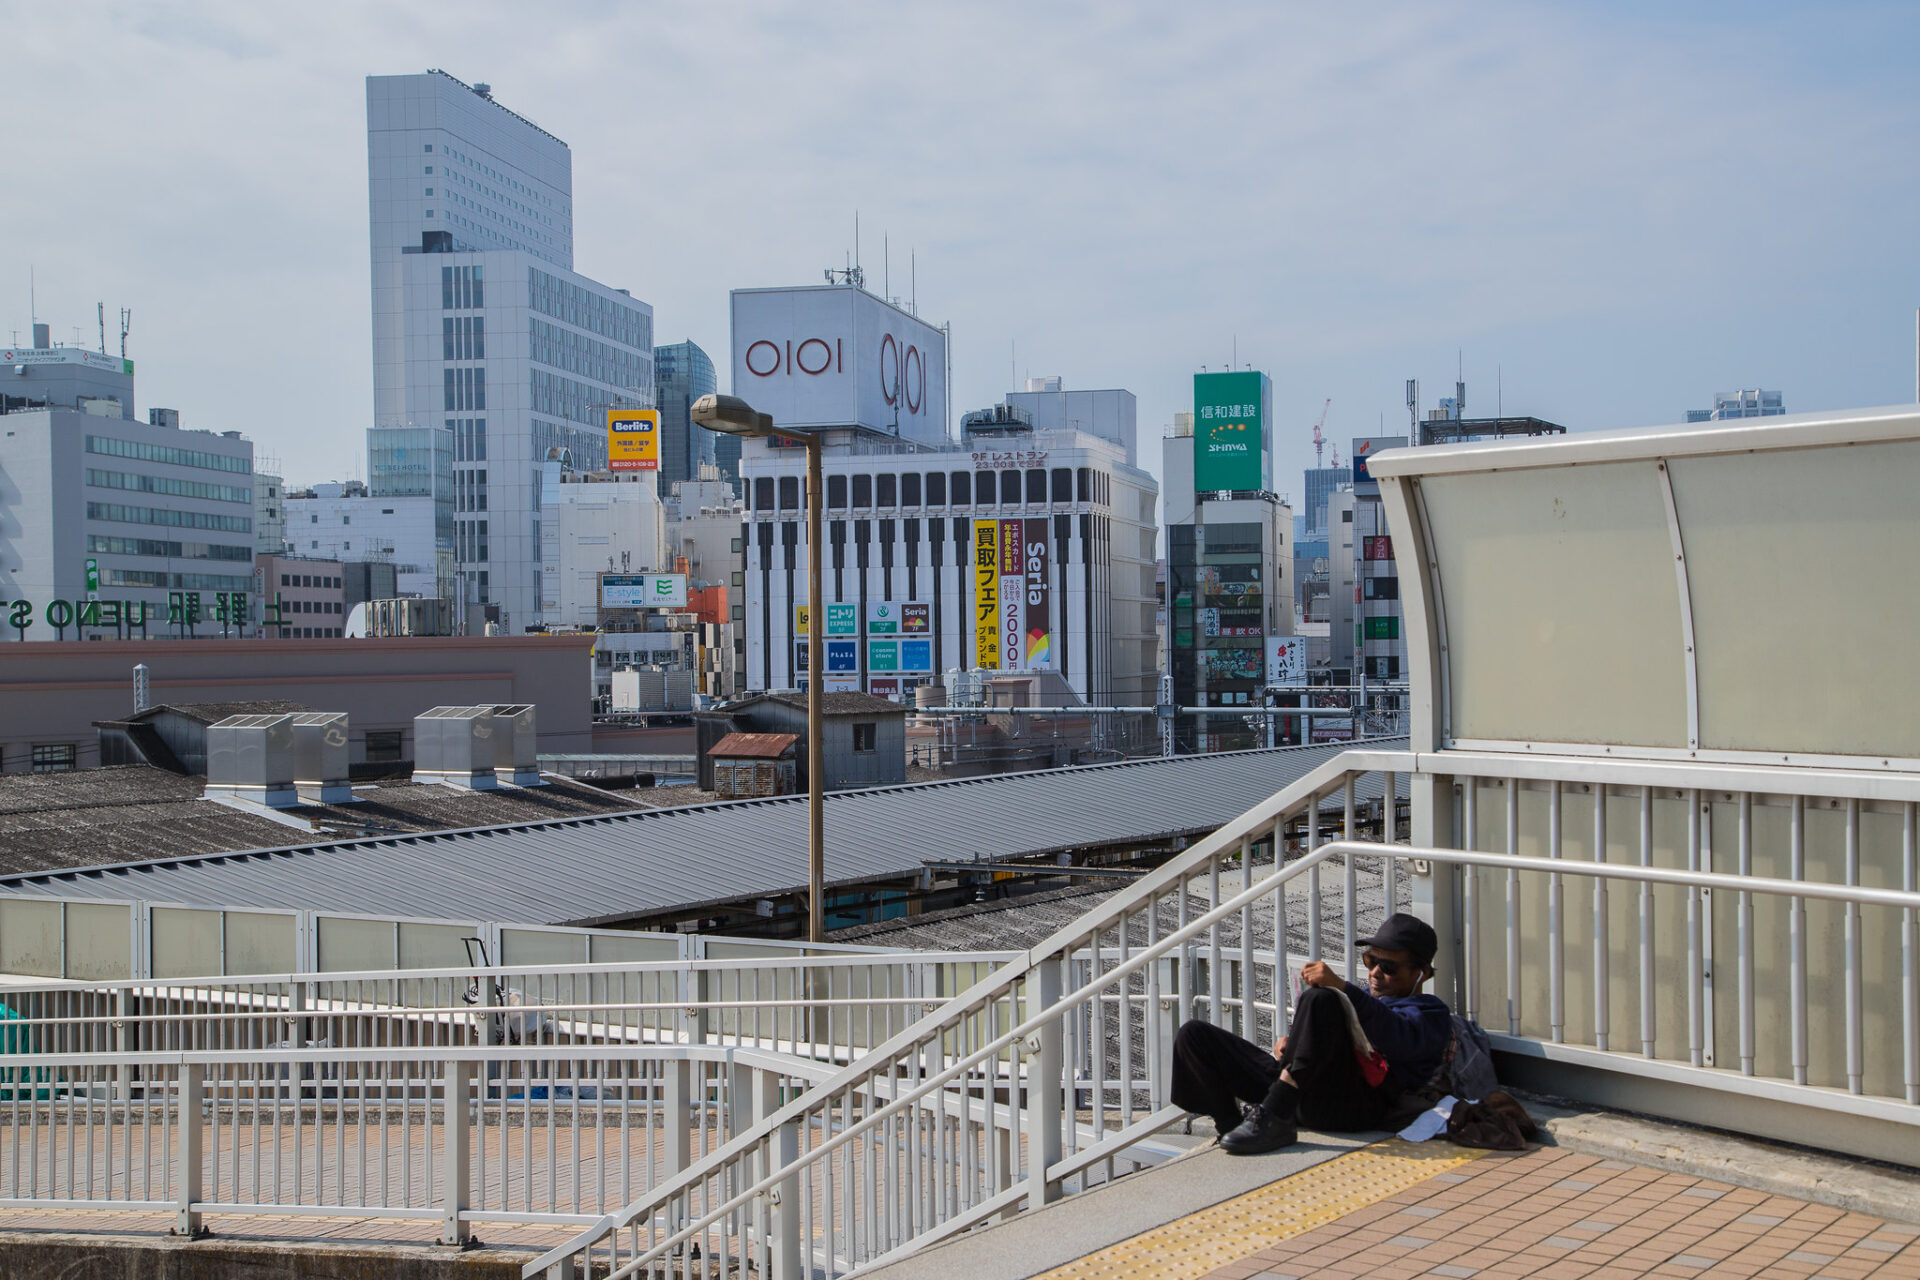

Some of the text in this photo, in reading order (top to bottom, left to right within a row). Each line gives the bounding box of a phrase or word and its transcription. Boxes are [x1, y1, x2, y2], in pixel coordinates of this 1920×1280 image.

[1201, 405, 1256, 418] 信和建設
[615, 421, 650, 431] Berlitz
[977, 527, 996, 621] 買取フェア
[1027, 542, 1048, 606] Seria
[829, 609, 854, 619] ニトリ
[904, 608, 927, 616] Seria
